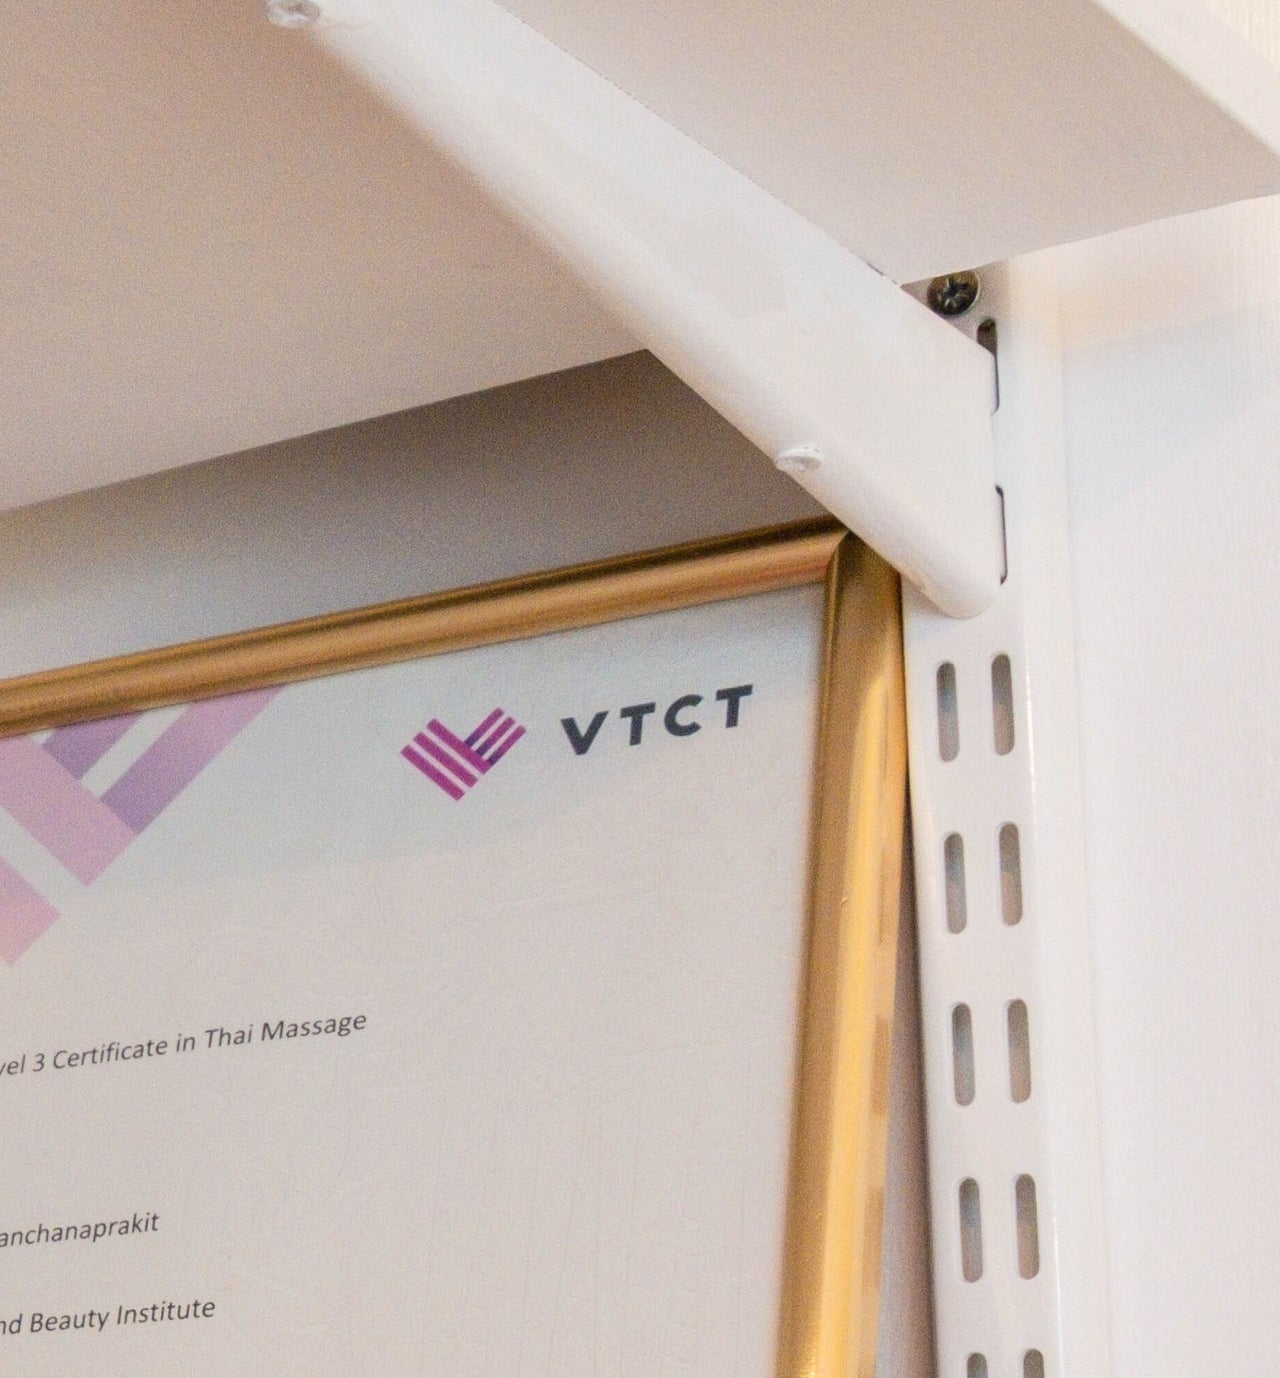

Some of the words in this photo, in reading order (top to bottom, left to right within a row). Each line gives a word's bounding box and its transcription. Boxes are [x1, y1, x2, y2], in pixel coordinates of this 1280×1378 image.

[560, 684, 754, 757] VTCT
[32, 1052, 46, 1074] 3
[52, 1036, 169, 1071] Certificate
[175, 1033, 197, 1054] in
[203, 1023, 253, 1051] Thai
[261, 1010, 368, 1051] Massage
[30, 1304, 110, 1338] Beauty
[116, 1294, 217, 1329] Institute
